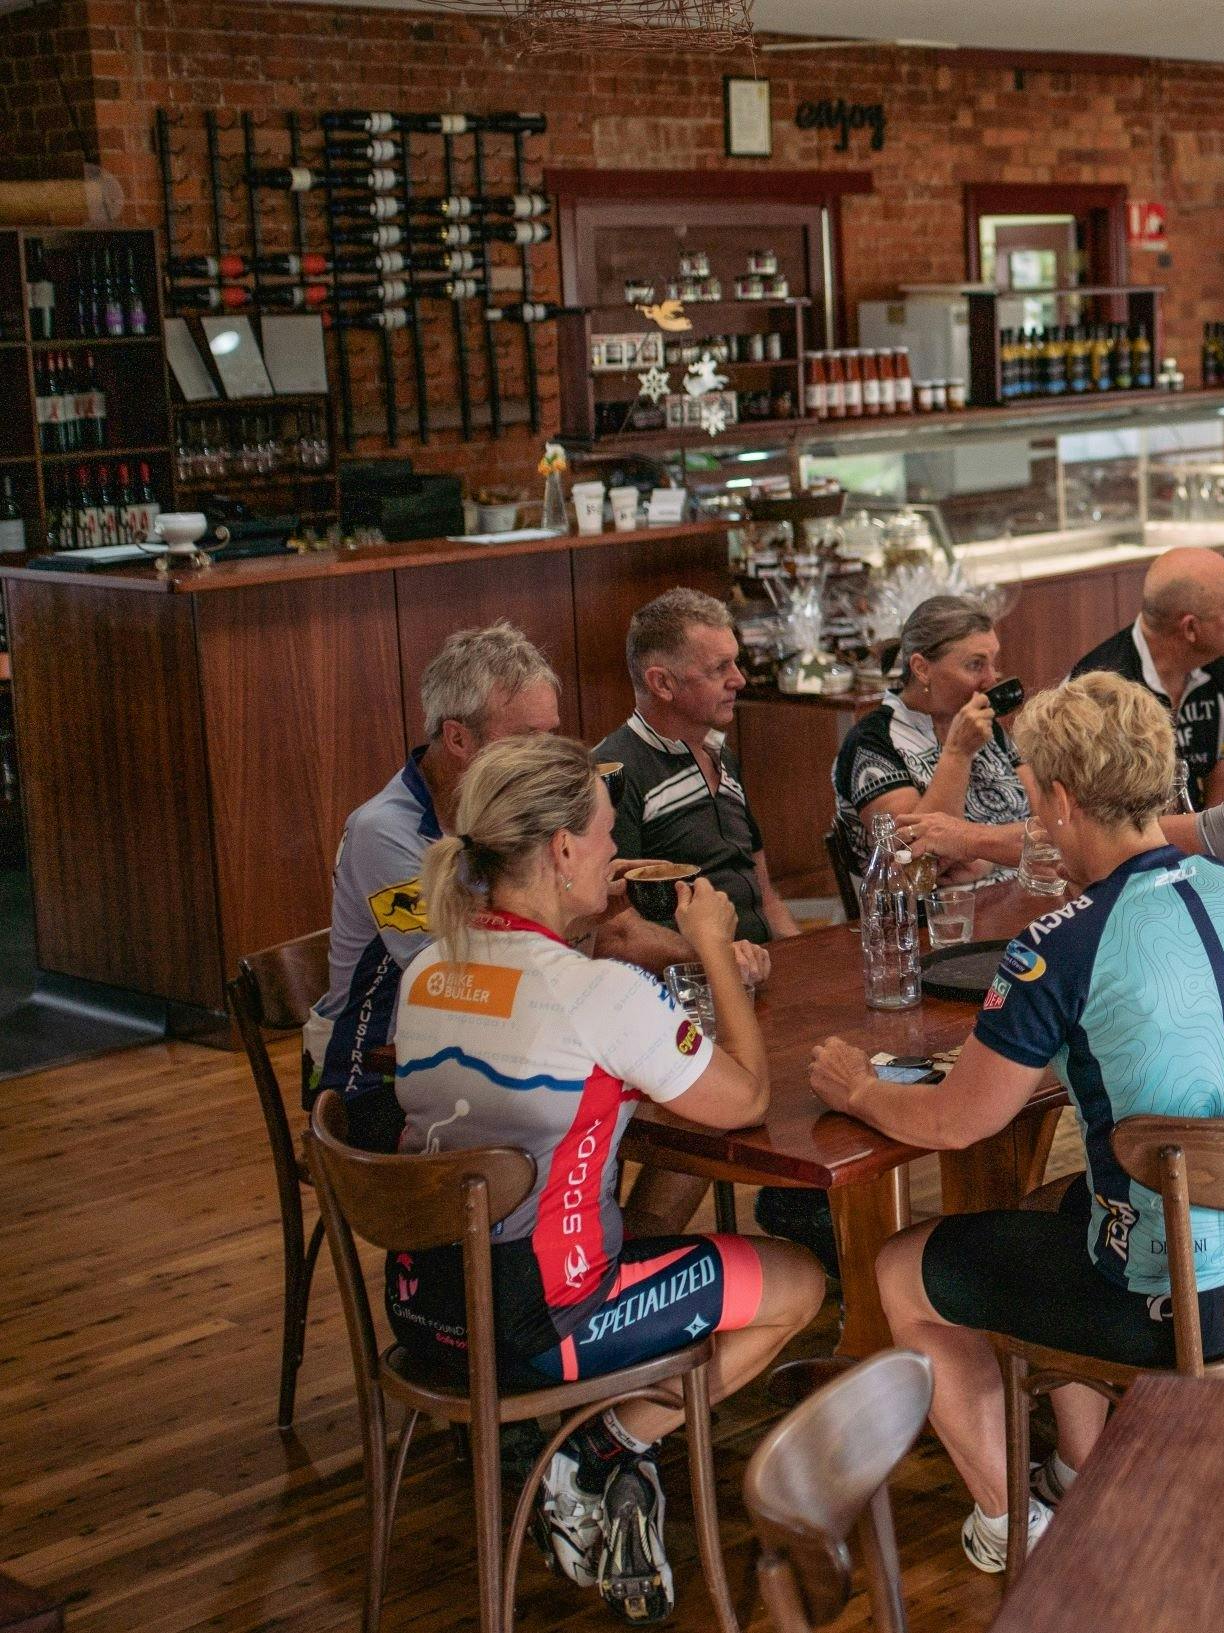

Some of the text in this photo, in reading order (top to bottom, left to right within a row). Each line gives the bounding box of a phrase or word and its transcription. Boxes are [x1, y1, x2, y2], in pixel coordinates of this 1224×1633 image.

[794, 98, 887, 152] enjoy
[1028, 894, 1094, 945] RACV
[443, 985, 492, 1005] BULLER
[992, 977, 1008, 995] AG
[562, 1118, 603, 1235] SCODY
[579, 1255, 716, 1346] SPECIALIZED
[427, 1318, 466, 1337] FOUND
